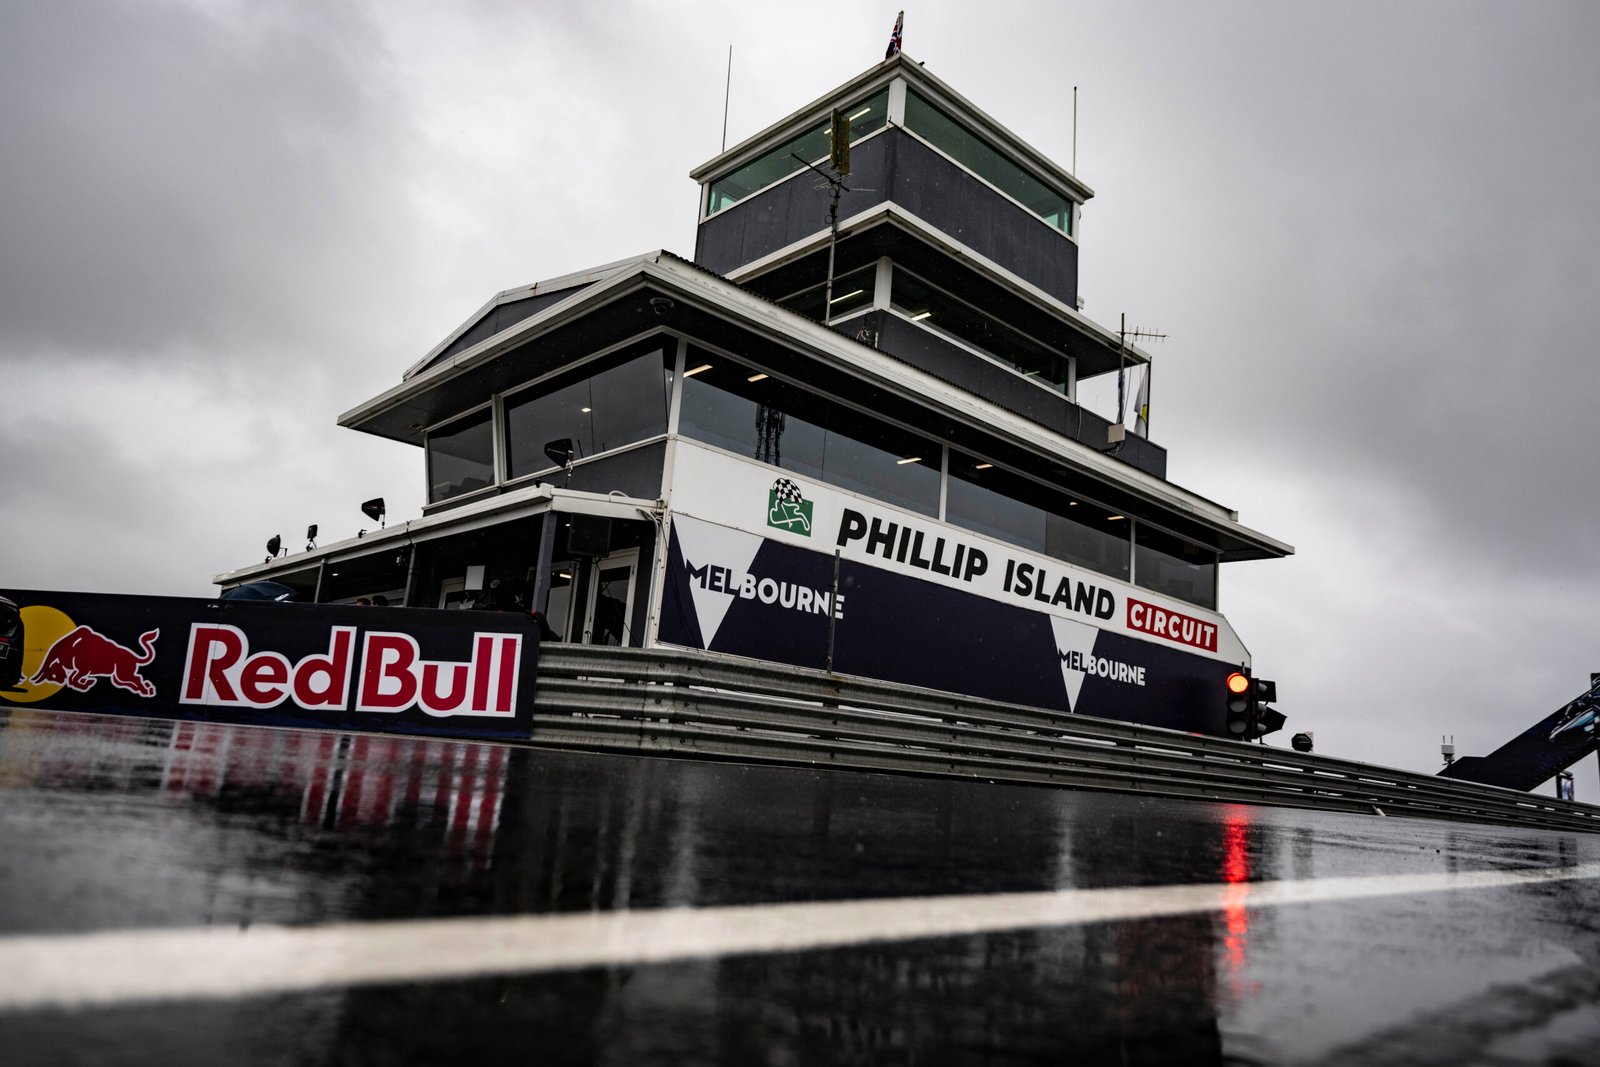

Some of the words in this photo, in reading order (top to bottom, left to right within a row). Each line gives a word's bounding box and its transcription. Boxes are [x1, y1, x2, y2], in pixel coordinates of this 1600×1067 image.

[686, 558, 845, 619] MELBOURNE
[836, 507, 989, 582] PHILLIP
[1003, 559, 1115, 621] ISLAND
[1130, 603, 1215, 648] CIRCUIT
[179, 622, 357, 710] Red
[355, 631, 523, 718] Bull
[1059, 648, 1146, 686] MELBOURNE
